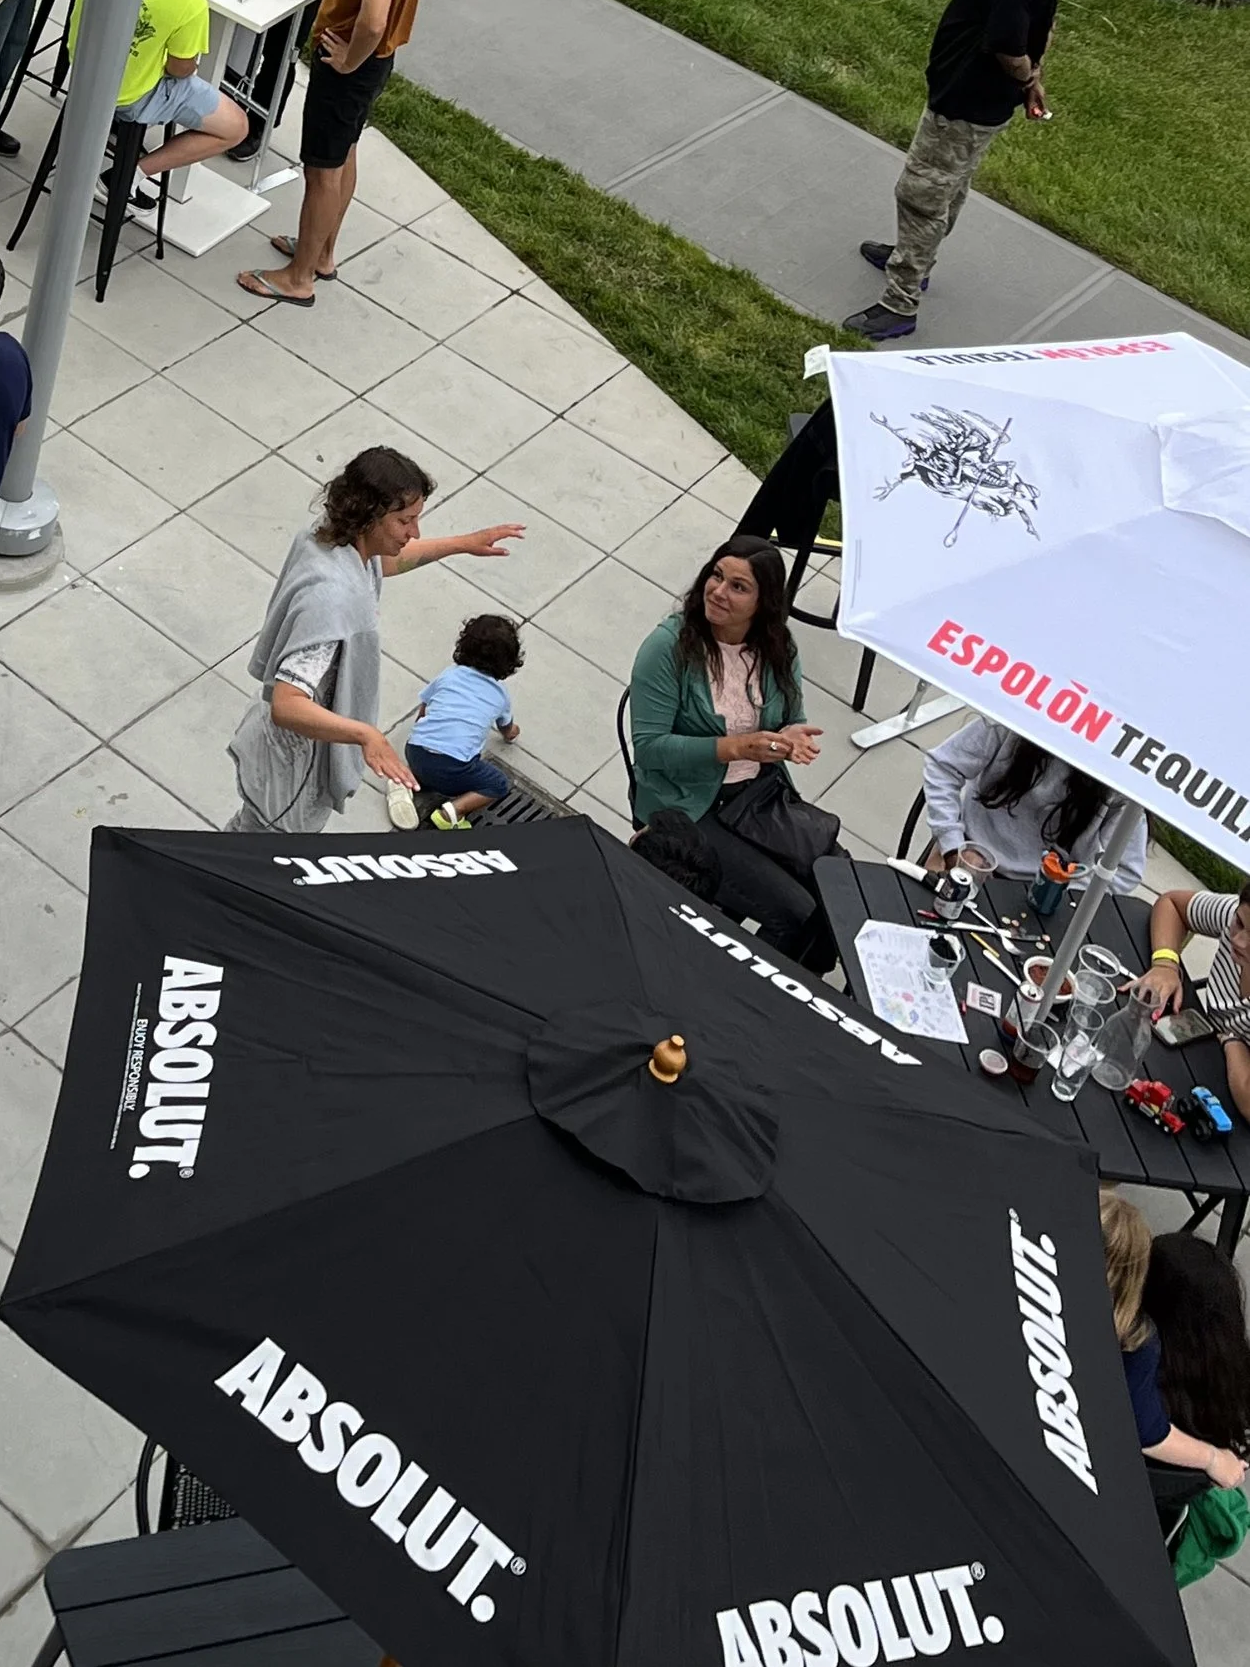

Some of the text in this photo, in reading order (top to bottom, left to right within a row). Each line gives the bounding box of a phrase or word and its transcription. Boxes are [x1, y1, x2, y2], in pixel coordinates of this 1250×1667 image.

[904, 350, 1043, 366] TEQUILA
[1111, 723, 1250, 842] TEQUIL
[134, 1018, 149, 1050] ENJOY
